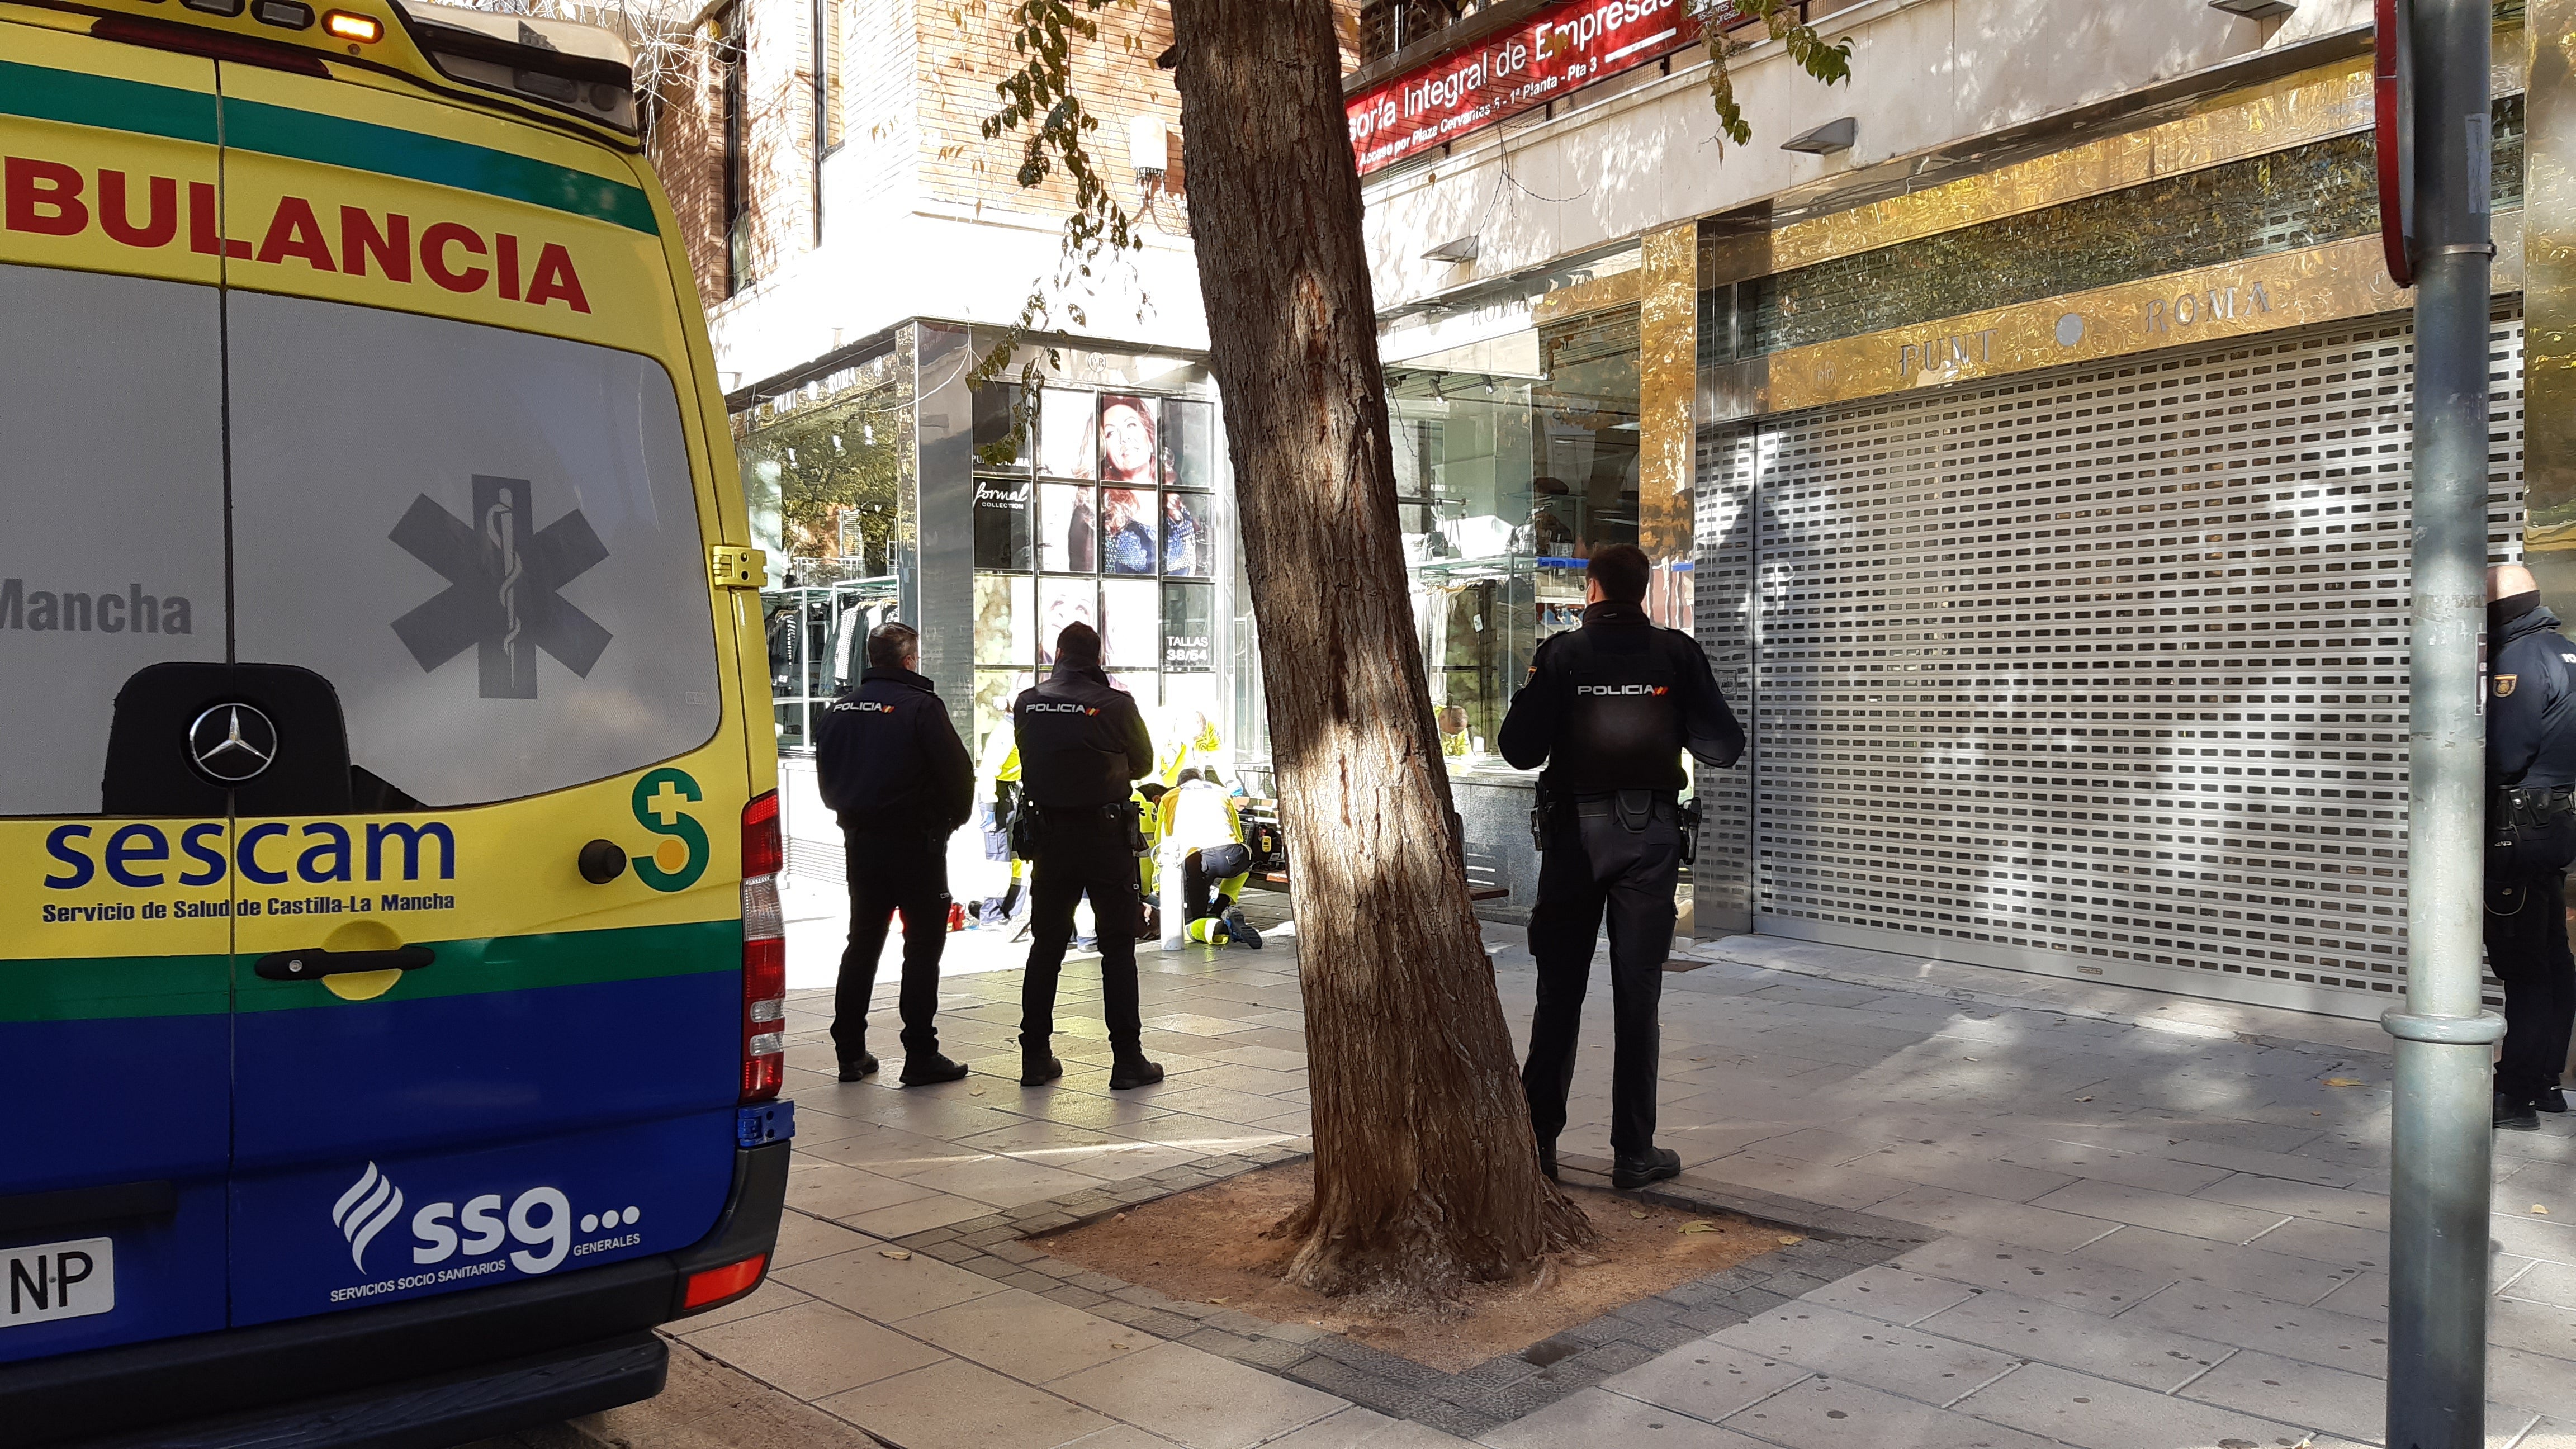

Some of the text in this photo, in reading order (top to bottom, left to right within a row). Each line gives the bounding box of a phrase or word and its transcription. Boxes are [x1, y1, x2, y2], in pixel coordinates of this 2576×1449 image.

[1404, 51, 1488, 117] Integral
[1496, 42, 1527, 77] de
[1535, 0, 1674, 61] Empresa
[1358, 143, 1393, 167] Acceso
[1394, 136, 1411, 158] por
[1412, 125, 1438, 145] Plaza
[1440, 103, 1491, 133] Cervantes
[1522, 75, 1559, 100] Planta
[1567, 61, 1587, 82] Pta
[1589, 56, 1597, 72] 3
[4, 156, 592, 314] BULANCIA
[1471, 292, 1531, 326] ROMA
[1900, 281, 2274, 377] PUNT ROMA
[972, 481, 1030, 508] formal
[1166, 636, 1209, 647] TALLAS
[1166, 649, 1208, 661] 38/54
[1577, 684, 1655, 695] POLICIA
[832, 702, 882, 712] POLICIA
[1026, 703, 1086, 713] POLICIA
[43, 821, 456, 890] sescam
[42, 892, 456, 923] Servicio de Salud de Castilla-La Mancha
[10, 1251, 94, 1315] NP
[330, 1233, 641, 1303] SERVICIOS SOCIO SANITARIOS GENERALES
